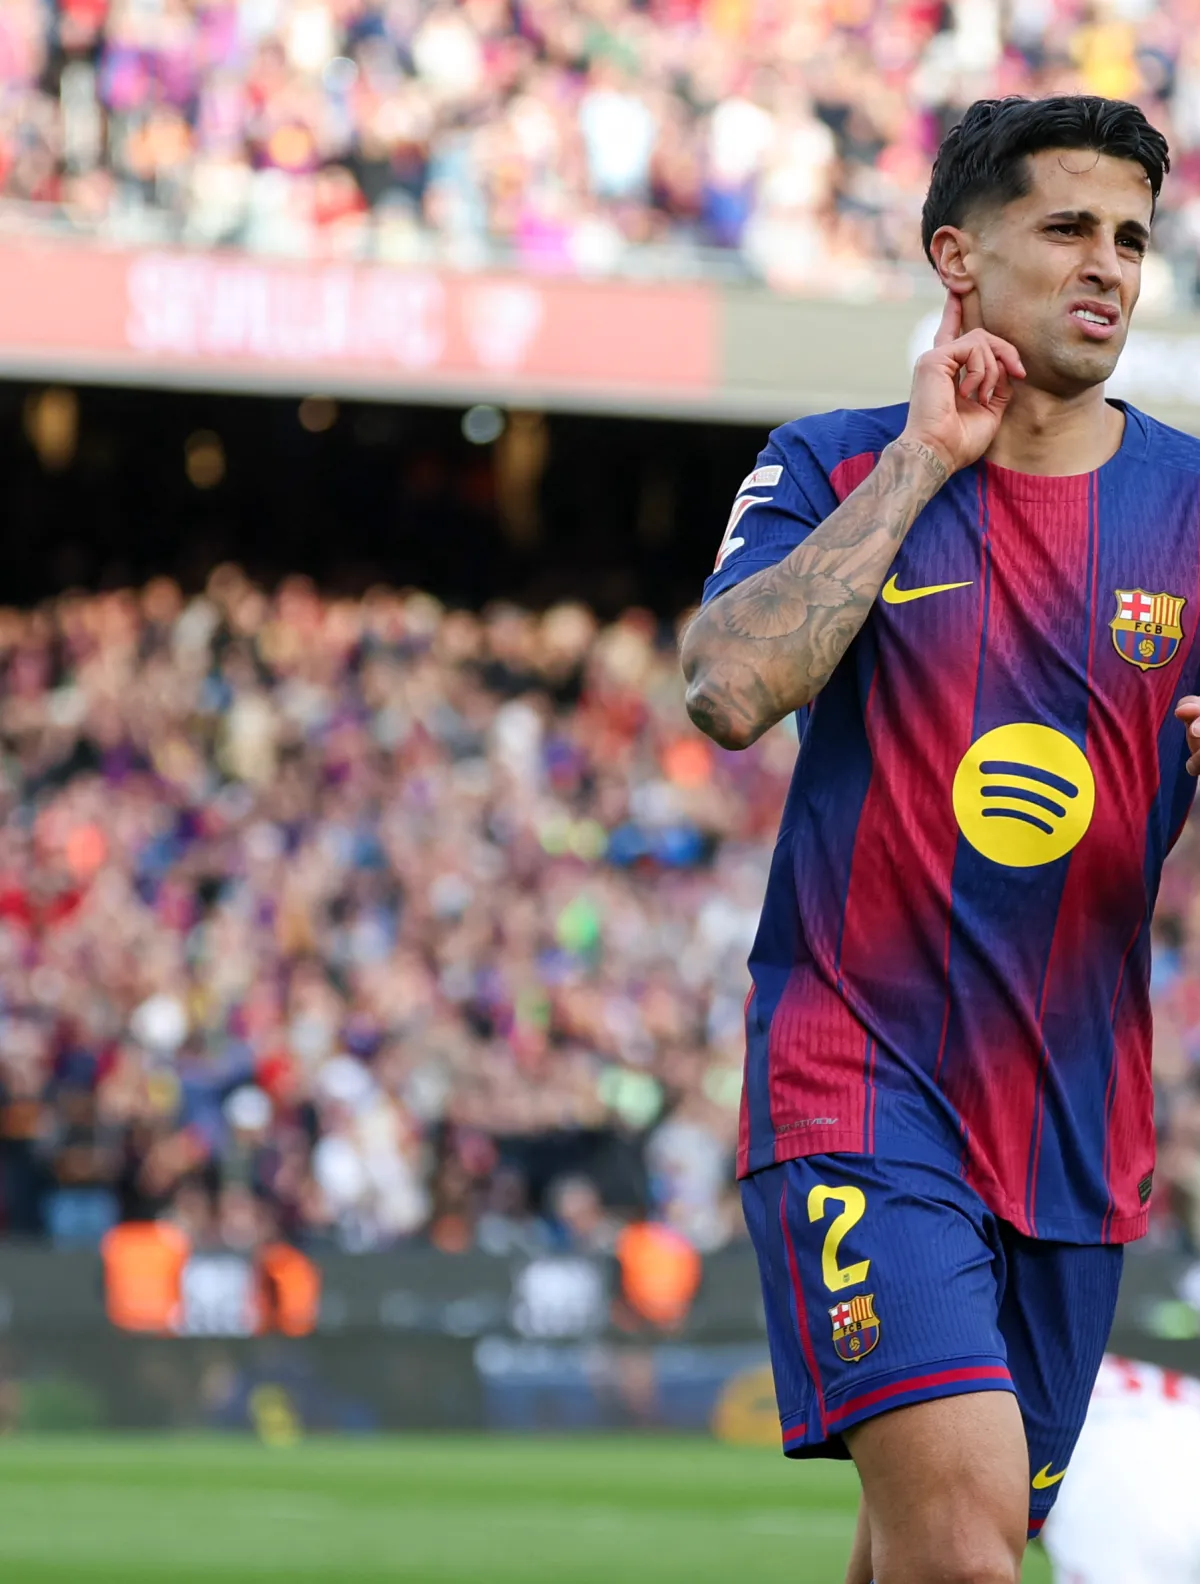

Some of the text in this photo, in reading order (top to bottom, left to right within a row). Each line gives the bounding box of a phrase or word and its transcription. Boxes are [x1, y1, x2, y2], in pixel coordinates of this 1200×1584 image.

[1134, 622, 1163, 635] FCB
[807, 1184, 871, 1293] 2
[843, 1322, 862, 1335] FCB
